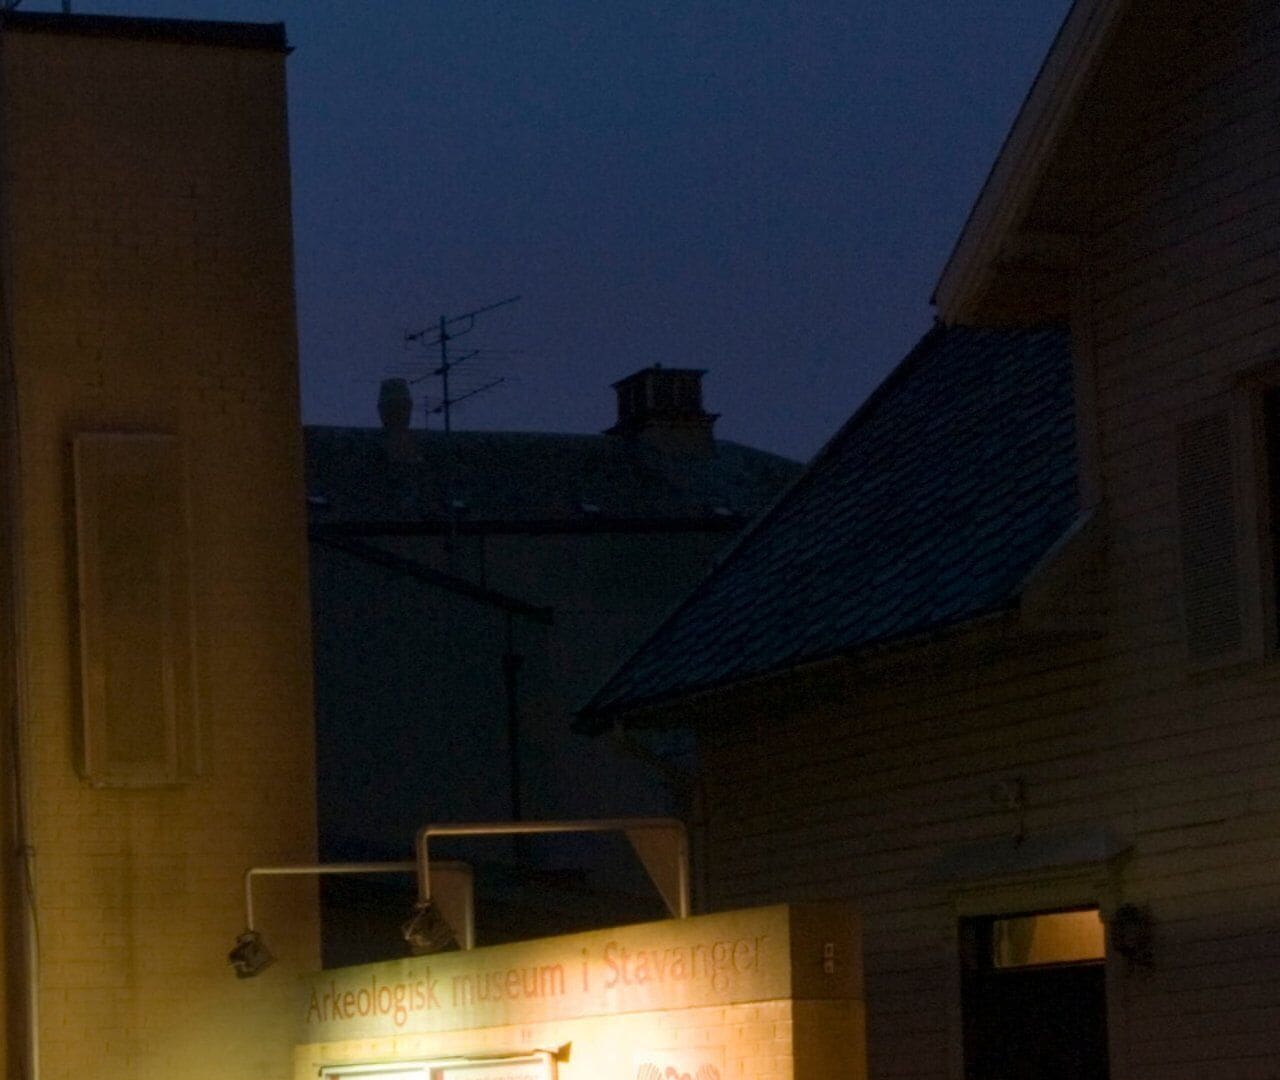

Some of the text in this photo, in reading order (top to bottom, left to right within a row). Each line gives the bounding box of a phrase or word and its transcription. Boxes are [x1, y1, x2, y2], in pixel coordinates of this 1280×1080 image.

[305, 934, 768, 1027] Arkeologisk museum i Stavanger
